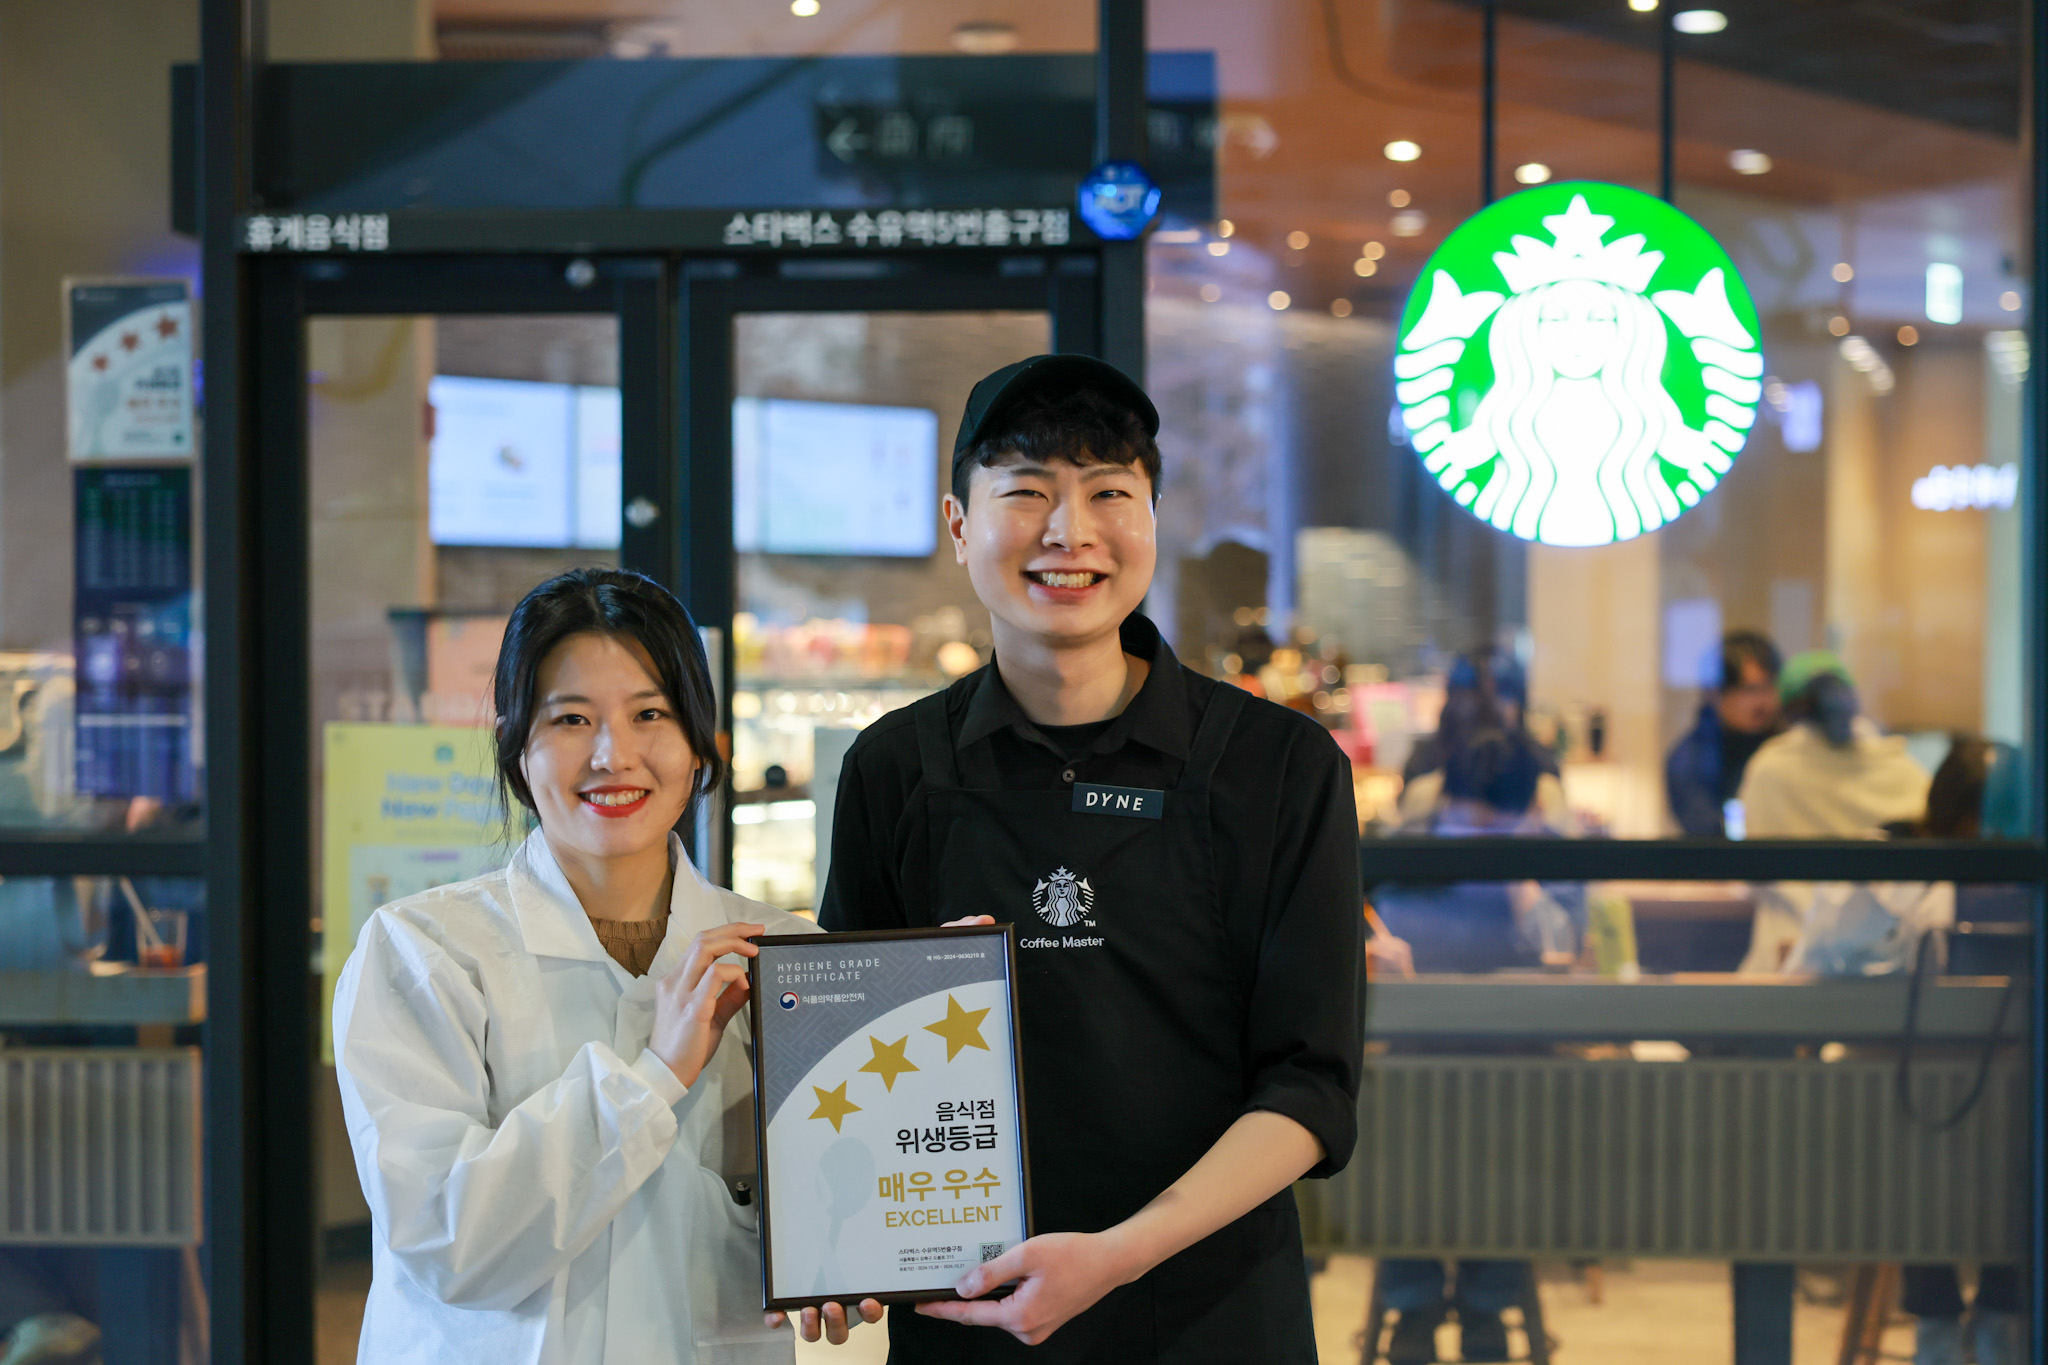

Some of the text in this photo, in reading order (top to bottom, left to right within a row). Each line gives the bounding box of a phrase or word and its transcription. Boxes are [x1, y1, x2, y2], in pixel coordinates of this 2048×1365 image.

[245, 213, 389, 251] 휴게음식점
[722, 209, 1070, 248] 스타벅스 수유역5번출구점
[1086, 792, 1144, 811] DYNE
[1020, 935, 1105, 949] Coffee Master
[777, 958, 880, 972] HYGIENE GRADE
[777, 971, 861, 984] CERTIFICATE
[802, 992, 865, 1004] 식품의약품안전처
[935, 1098, 996, 1122] 음식점
[895, 1124, 999, 1154] 위생등급
[878, 1167, 1001, 1203] 매우 우수
[885, 1205, 1003, 1228] EXCELLENT
